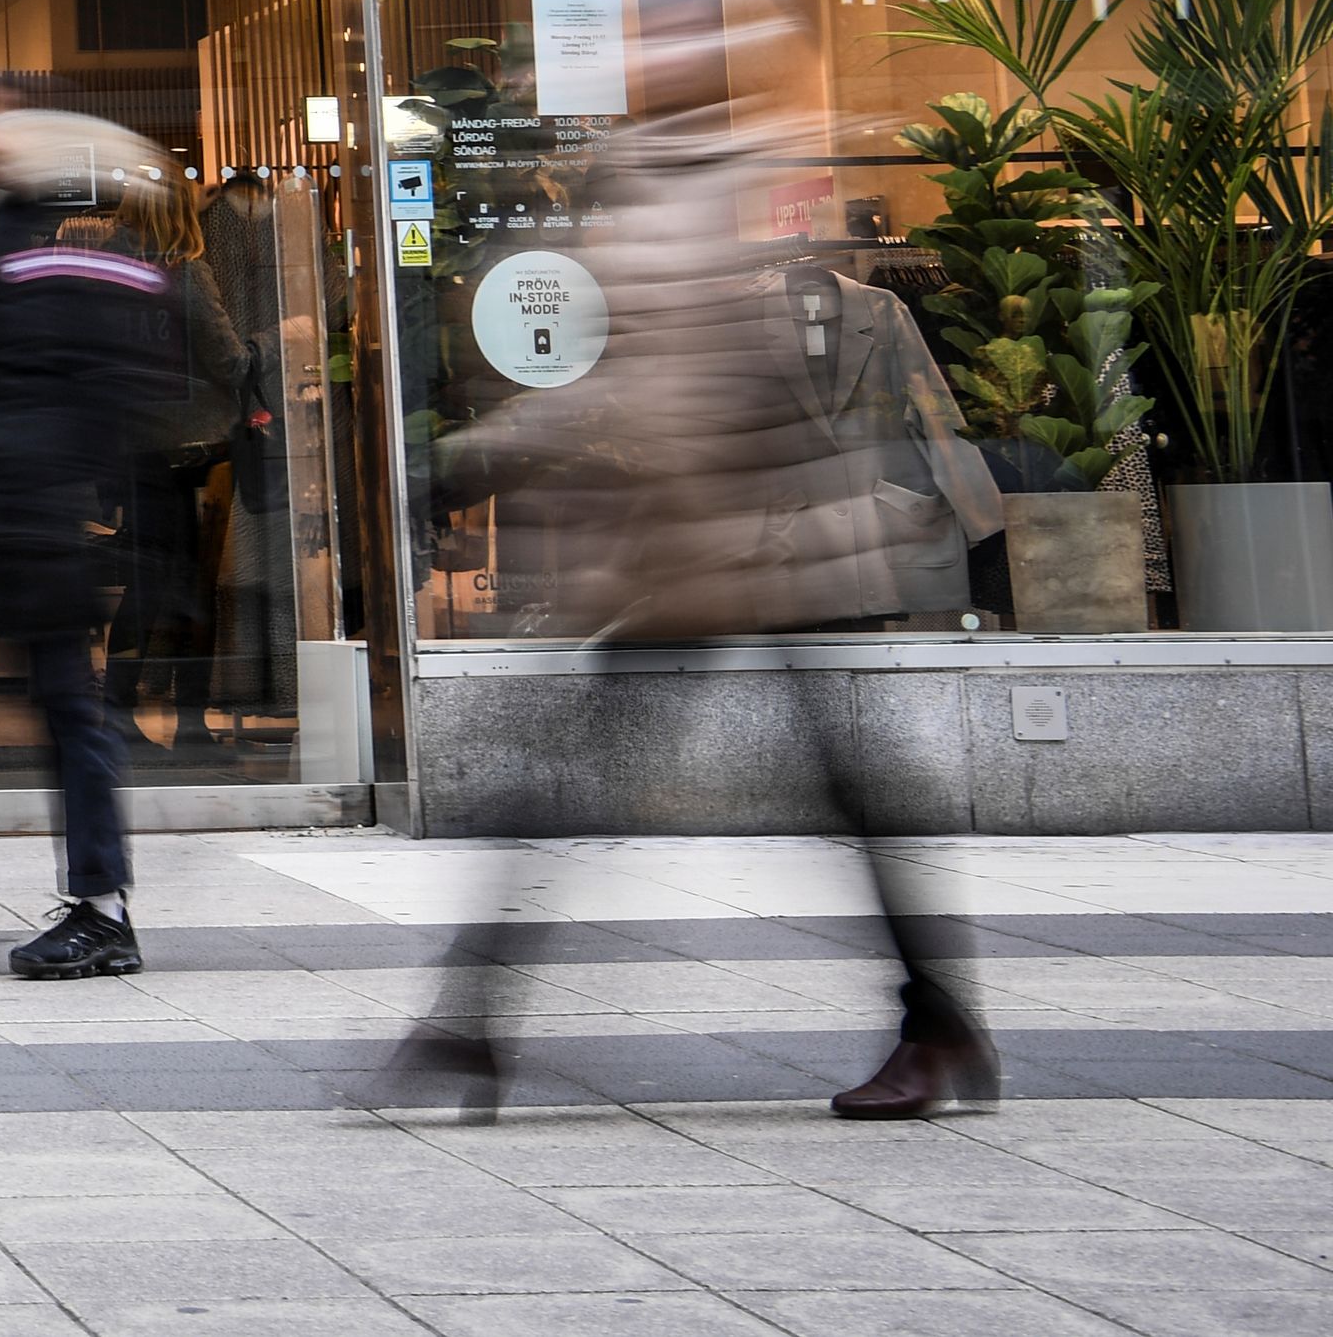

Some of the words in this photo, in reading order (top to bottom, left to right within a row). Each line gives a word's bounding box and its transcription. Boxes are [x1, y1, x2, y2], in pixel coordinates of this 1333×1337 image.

[452, 131, 495, 143] LÖRDAG
[453, 145, 498, 157] SÖNDAG
[517, 277, 561, 291] PRÖVA
[509, 291, 571, 303] IN-STORE
[521, 303, 560, 315] MODE
